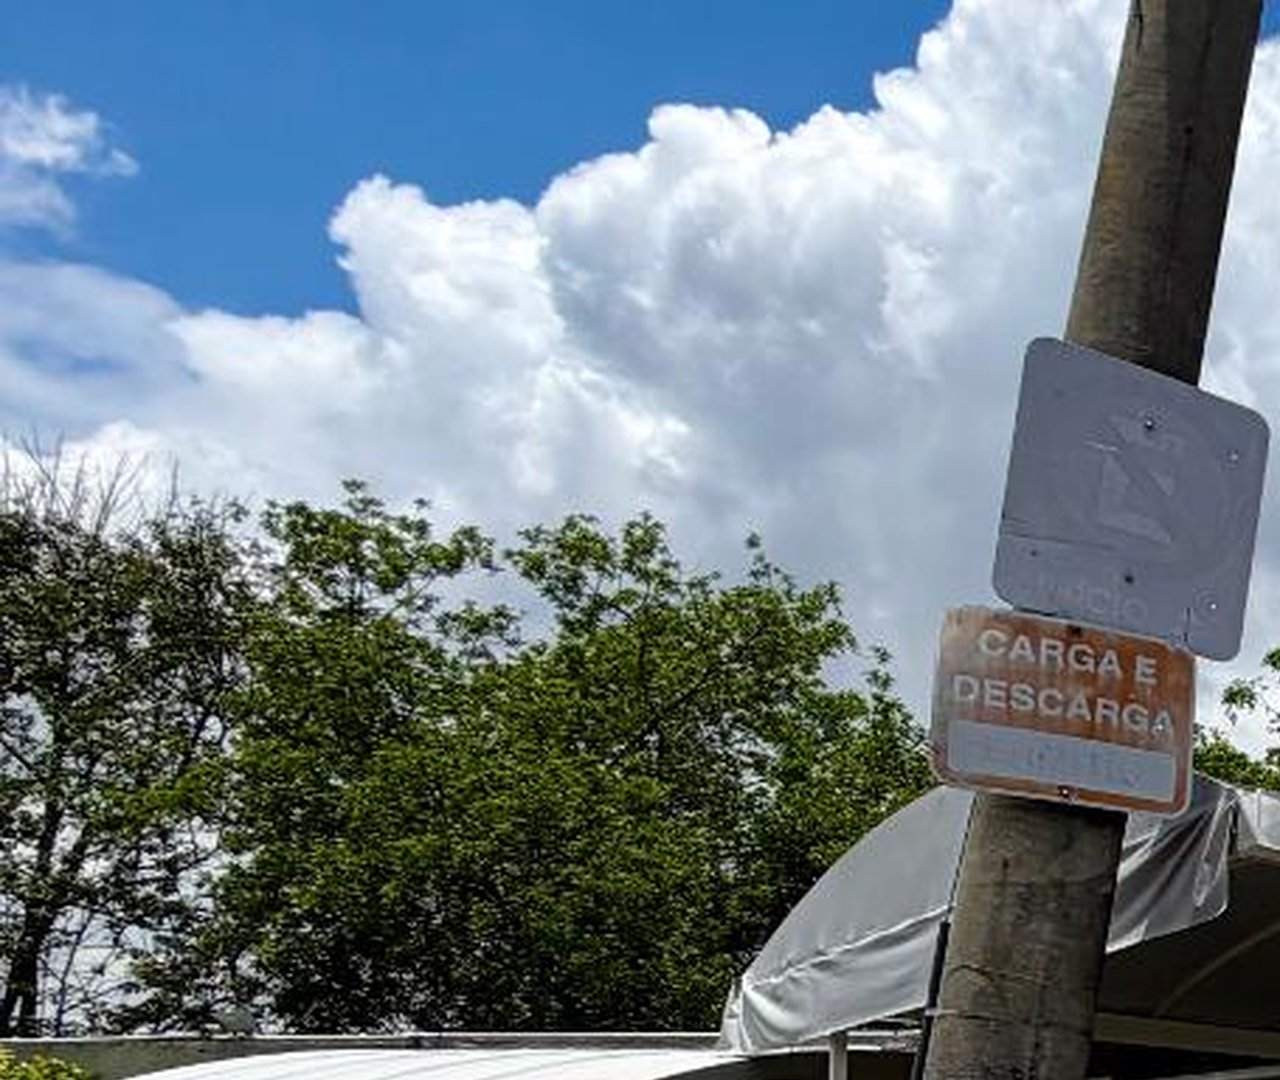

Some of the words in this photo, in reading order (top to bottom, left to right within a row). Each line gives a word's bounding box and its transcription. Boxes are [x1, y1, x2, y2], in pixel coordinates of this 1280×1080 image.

[978, 628, 1123, 680] CARGA
[1134, 655, 1158, 686] E
[953, 674, 1174, 737] DESCARGA
